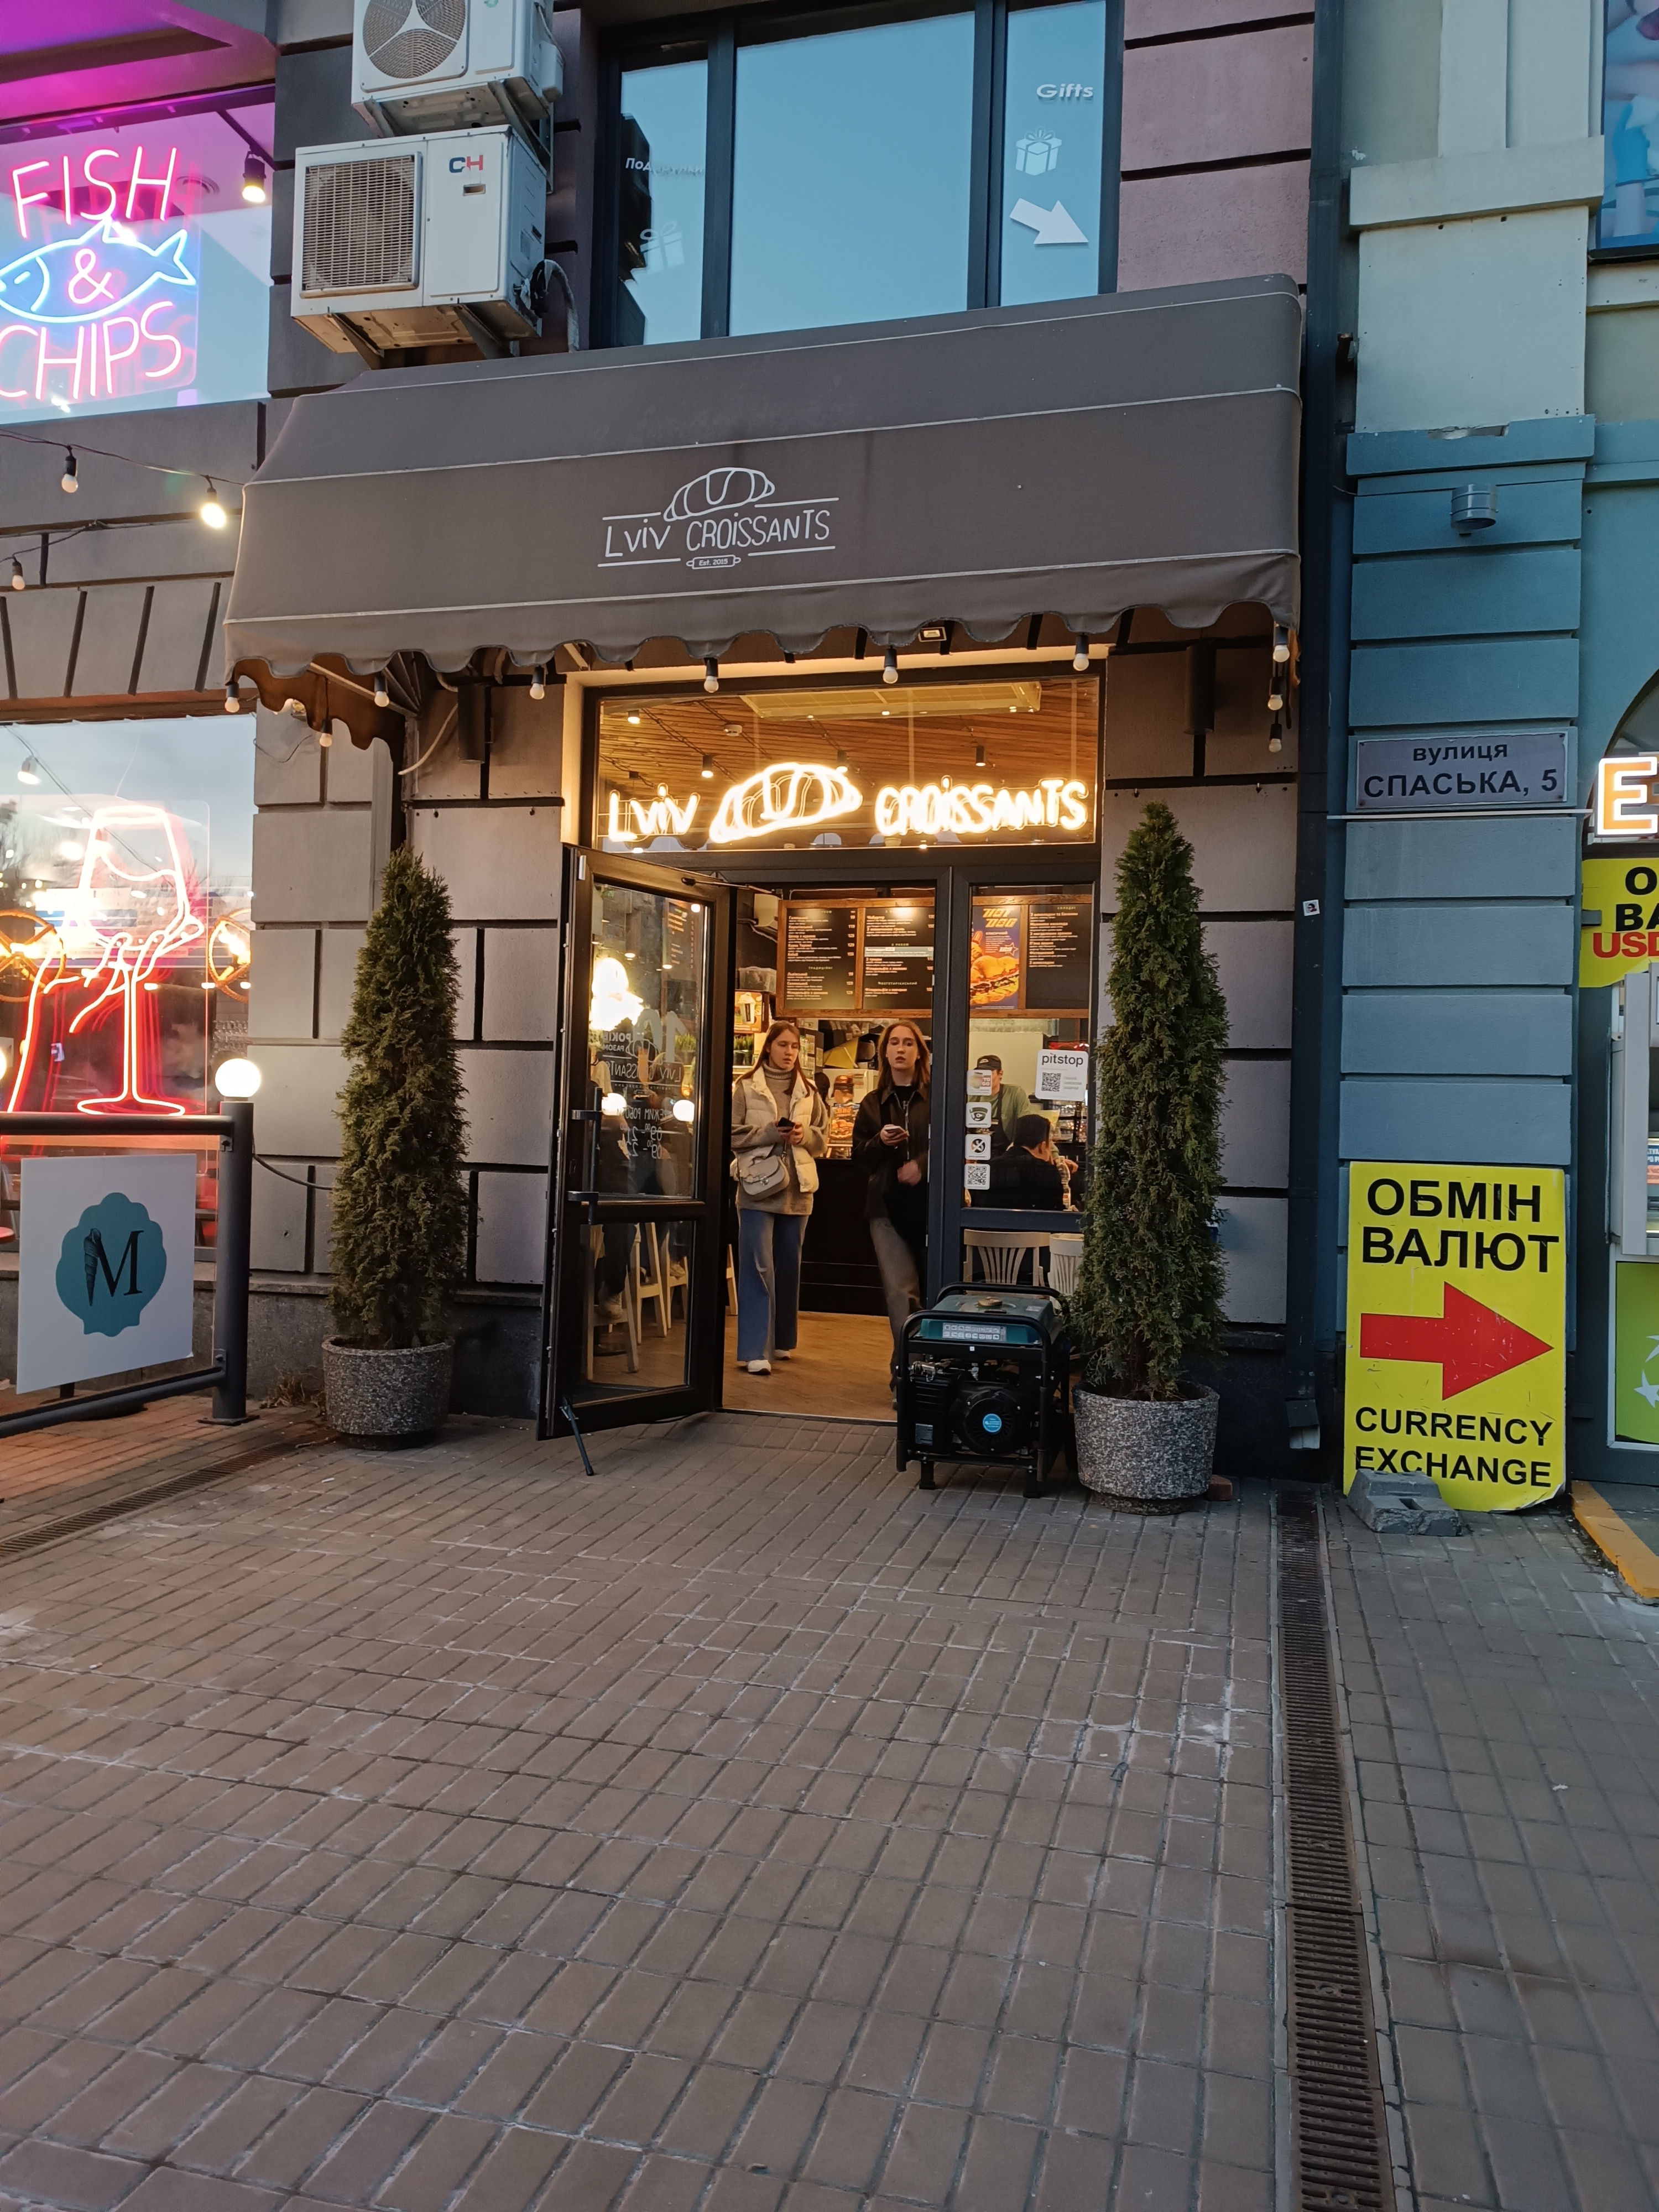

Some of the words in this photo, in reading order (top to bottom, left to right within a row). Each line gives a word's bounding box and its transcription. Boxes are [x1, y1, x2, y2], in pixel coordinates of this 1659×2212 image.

[1036, 82, 1094, 99] Gifts
[448, 154, 484, 174] CH
[12, 145, 177, 238] FISH
[68, 248, 115, 305] &
[0, 300, 182, 400] CHIPS
[1413, 744, 1508, 766] вулиця
[1364, 770, 1529, 797] СПАСЬКА,
[1541, 769, 1557, 792] 5
[982, 907, 1015, 918] HOT
[985, 918, 1018, 928] DOG
[1041, 1052, 1083, 1067] pitstop
[1367, 1178, 1541, 1223] ОБМІН
[1362, 1226, 1560, 1274] ВАЛЮТ
[1355, 1406, 1553, 1447] CURRENCY
[1355, 1446, 1552, 1488] EXCHANGE
